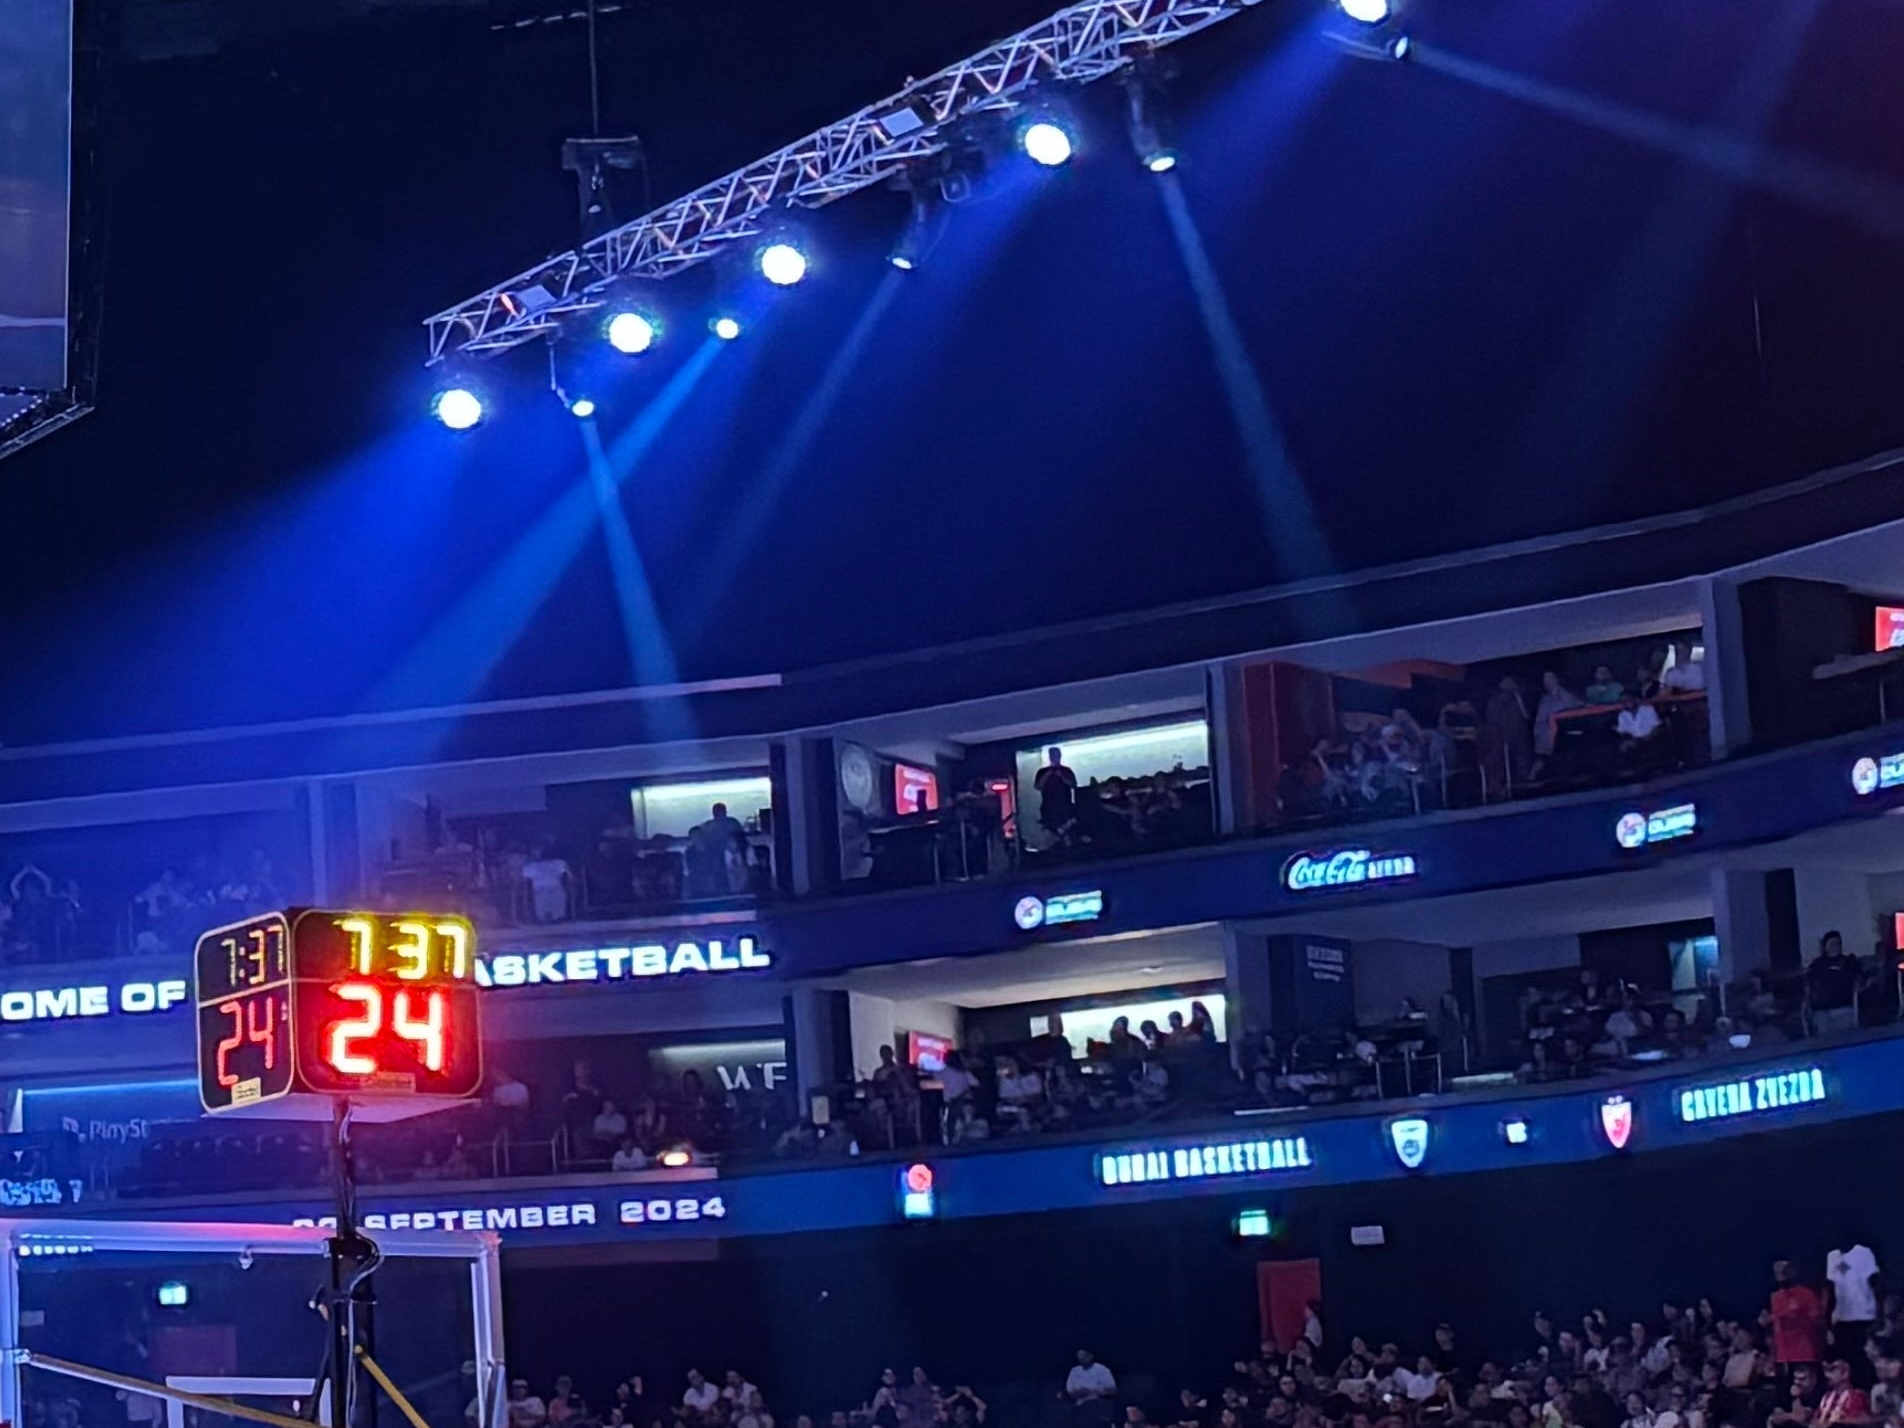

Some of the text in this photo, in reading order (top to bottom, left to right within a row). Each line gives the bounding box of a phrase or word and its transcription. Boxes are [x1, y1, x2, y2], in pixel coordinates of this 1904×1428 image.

[475, 939, 769, 986] SKETBALL
[122, 981, 185, 1011] OF
[216, 997, 274, 1086] 24
[324, 983, 444, 1074] 24
[1174, 1138, 1310, 1177] BASKETBALL
[621, 1197, 725, 1222] 2024
